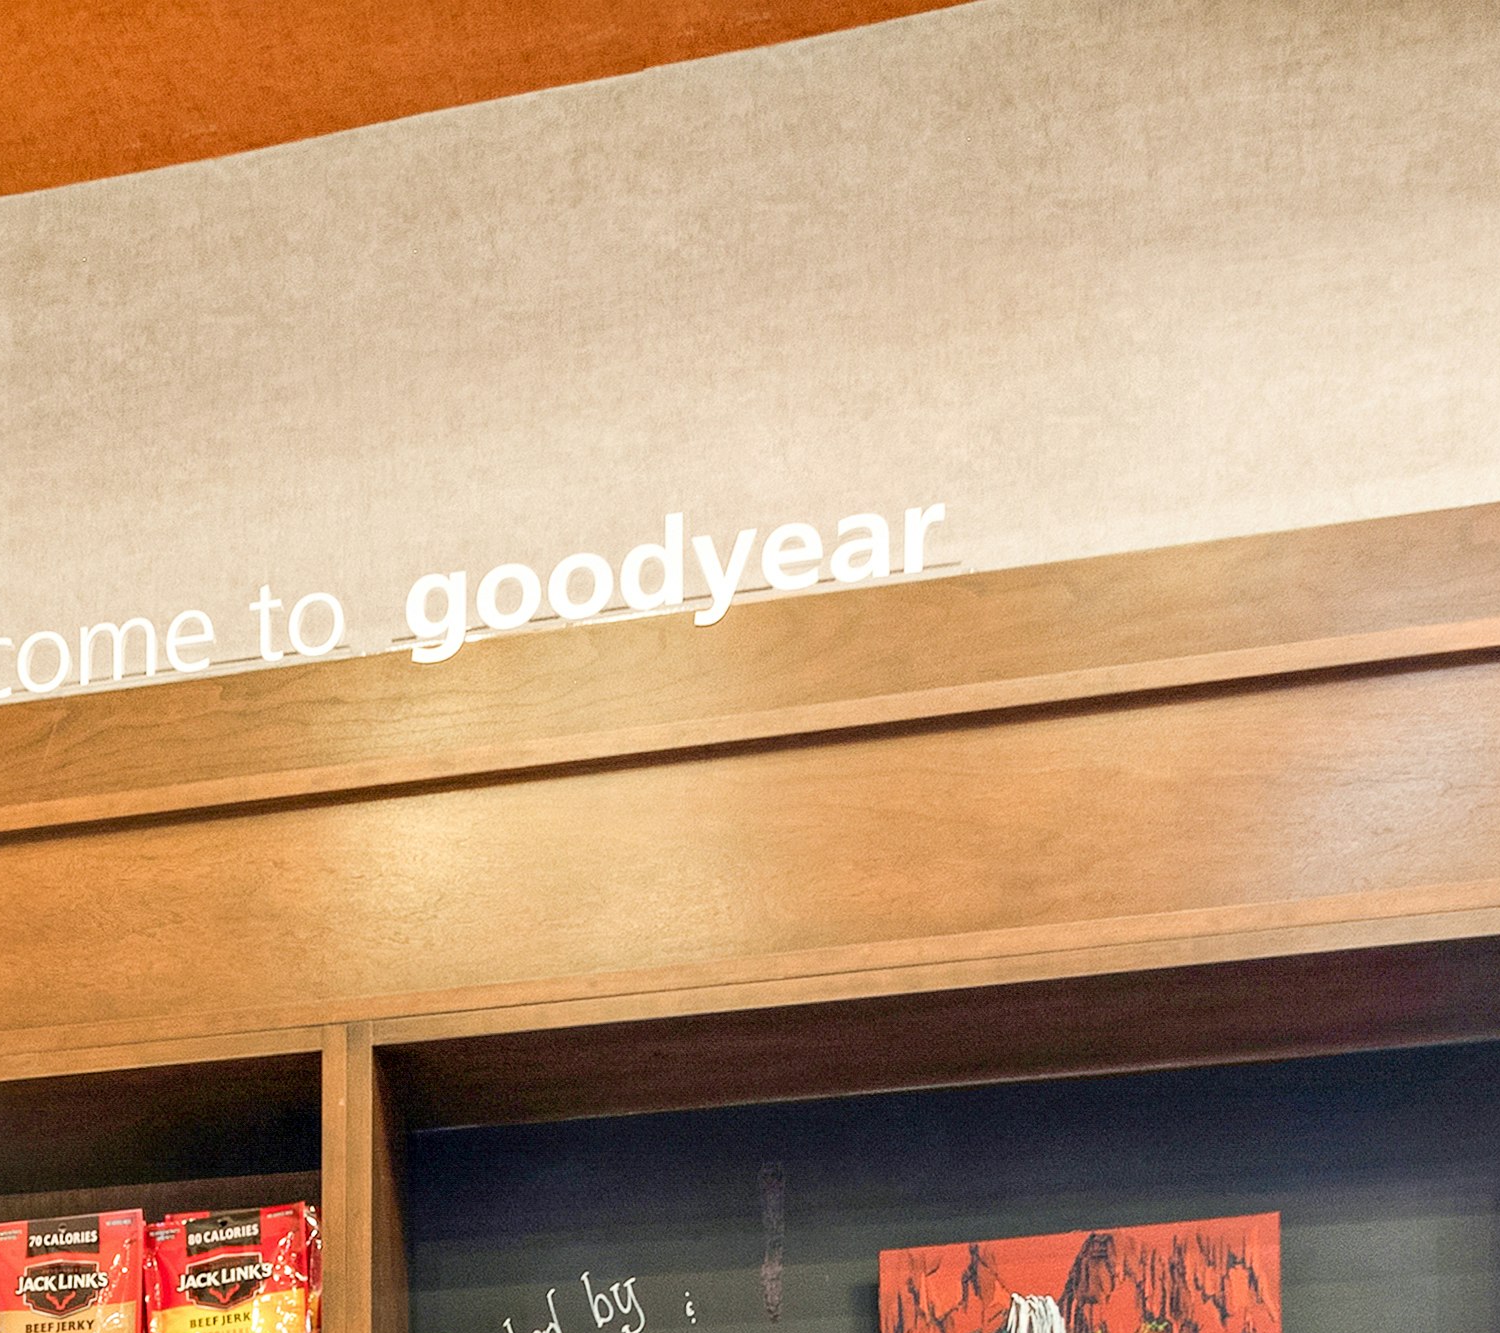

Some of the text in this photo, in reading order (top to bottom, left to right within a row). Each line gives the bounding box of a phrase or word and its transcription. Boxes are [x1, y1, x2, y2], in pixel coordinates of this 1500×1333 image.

[250, 584, 345, 659] to
[403, 503, 946, 664] goodyear
[28, 1229, 98, 1248] 70 CALORIES
[187, 1223, 260, 1246] 80 CALORIES
[16, 1276, 56, 1296] JACK
[54, 1318, 95, 1333] JERKY
